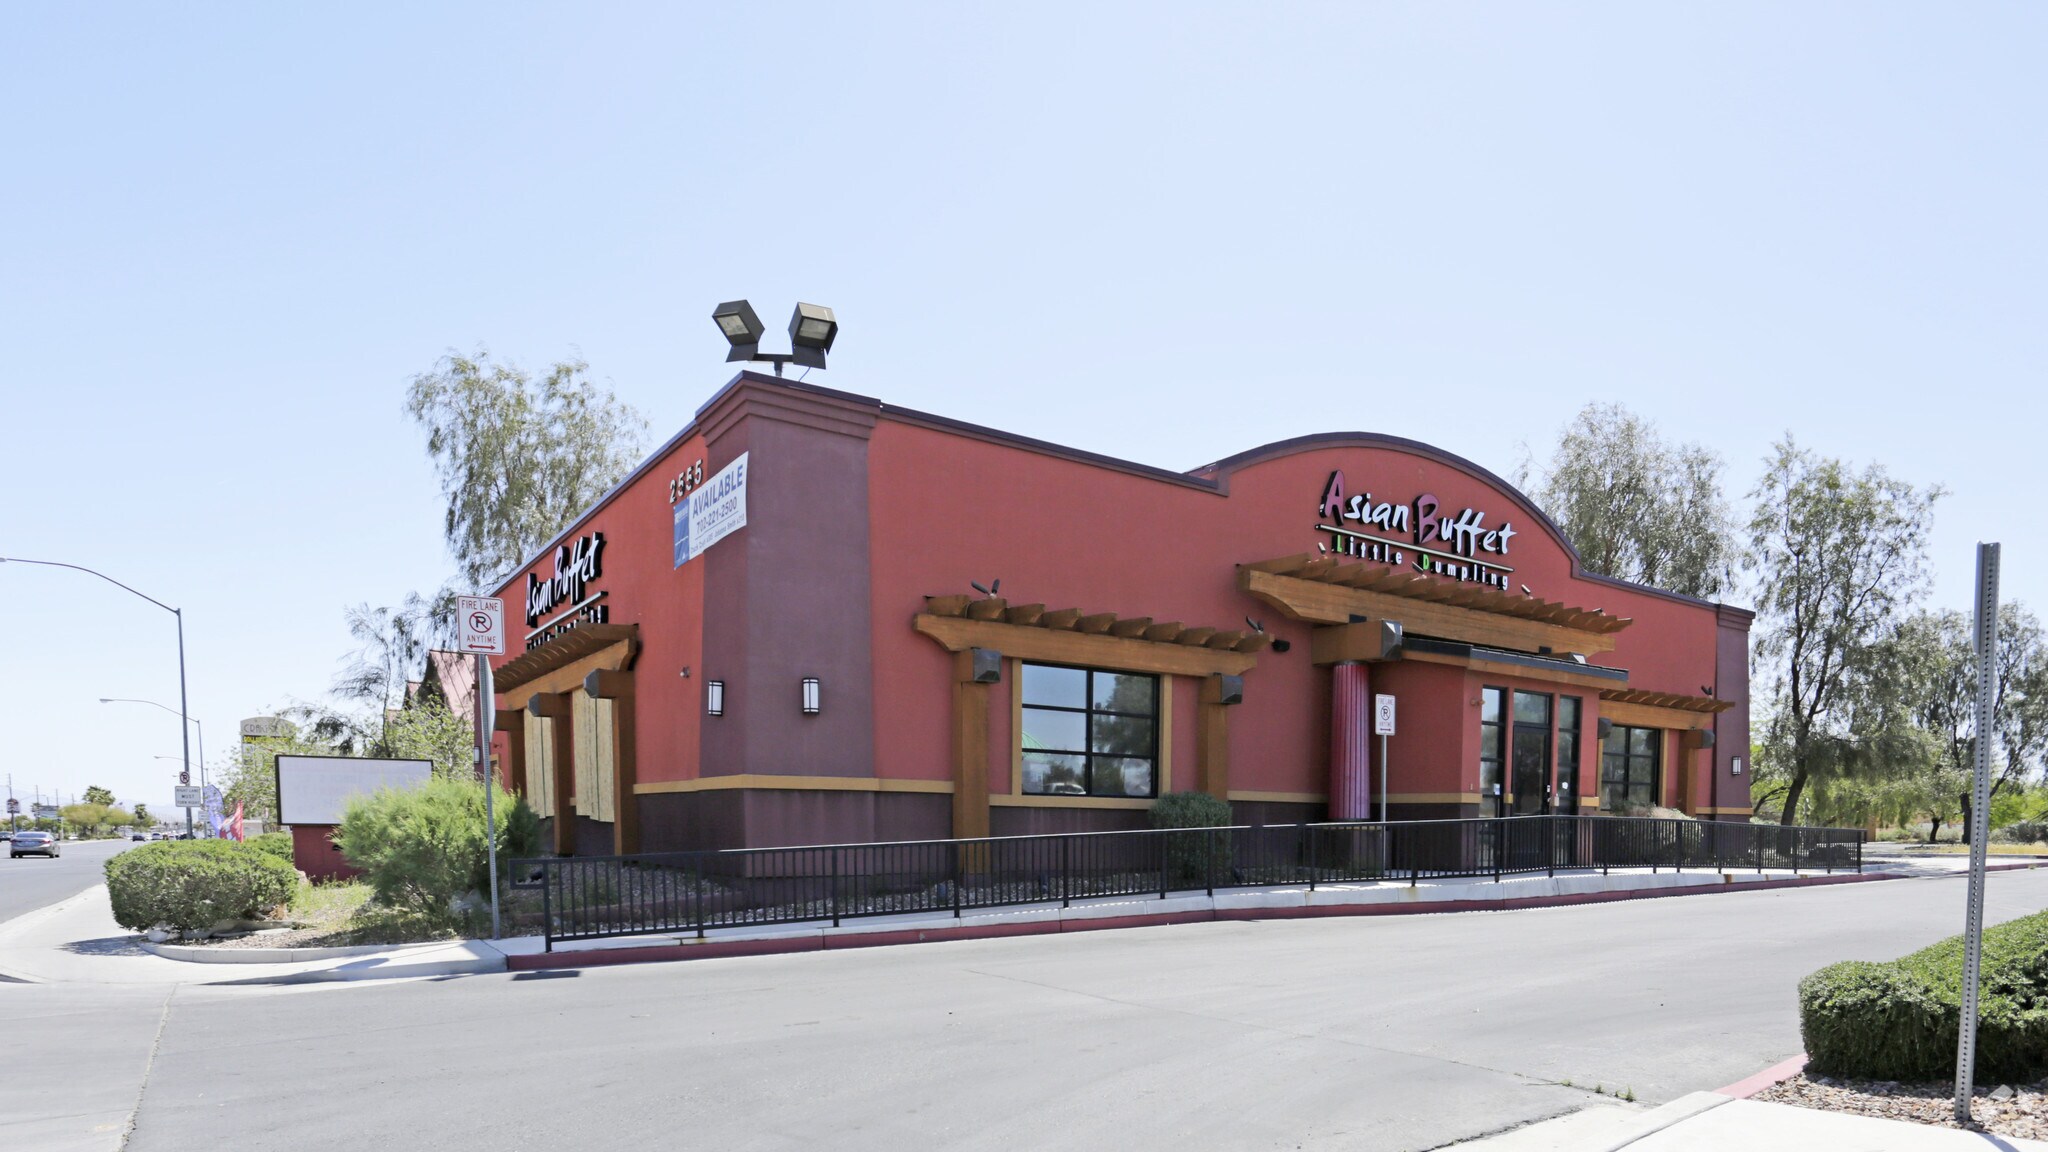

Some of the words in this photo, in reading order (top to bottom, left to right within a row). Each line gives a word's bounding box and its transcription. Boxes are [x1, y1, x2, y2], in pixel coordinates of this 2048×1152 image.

[669, 459, 703, 504] 2555
[692, 464, 744, 519] AVAILABLE
[696, 496, 738, 535] 702-221-2500
[1320, 470, 1409, 532] Asian
[1413, 493, 1518, 557] Buffet
[525, 572, 557, 628] Asian
[554, 531, 607, 606] Buffet
[1331, 534, 1403, 565] Little
[1417, 553, 1509, 591] Dumpling
[461, 600, 478, 610] FIRE
[480, 601, 499, 611] LANE
[466, 634, 497, 644] ANYTIME
